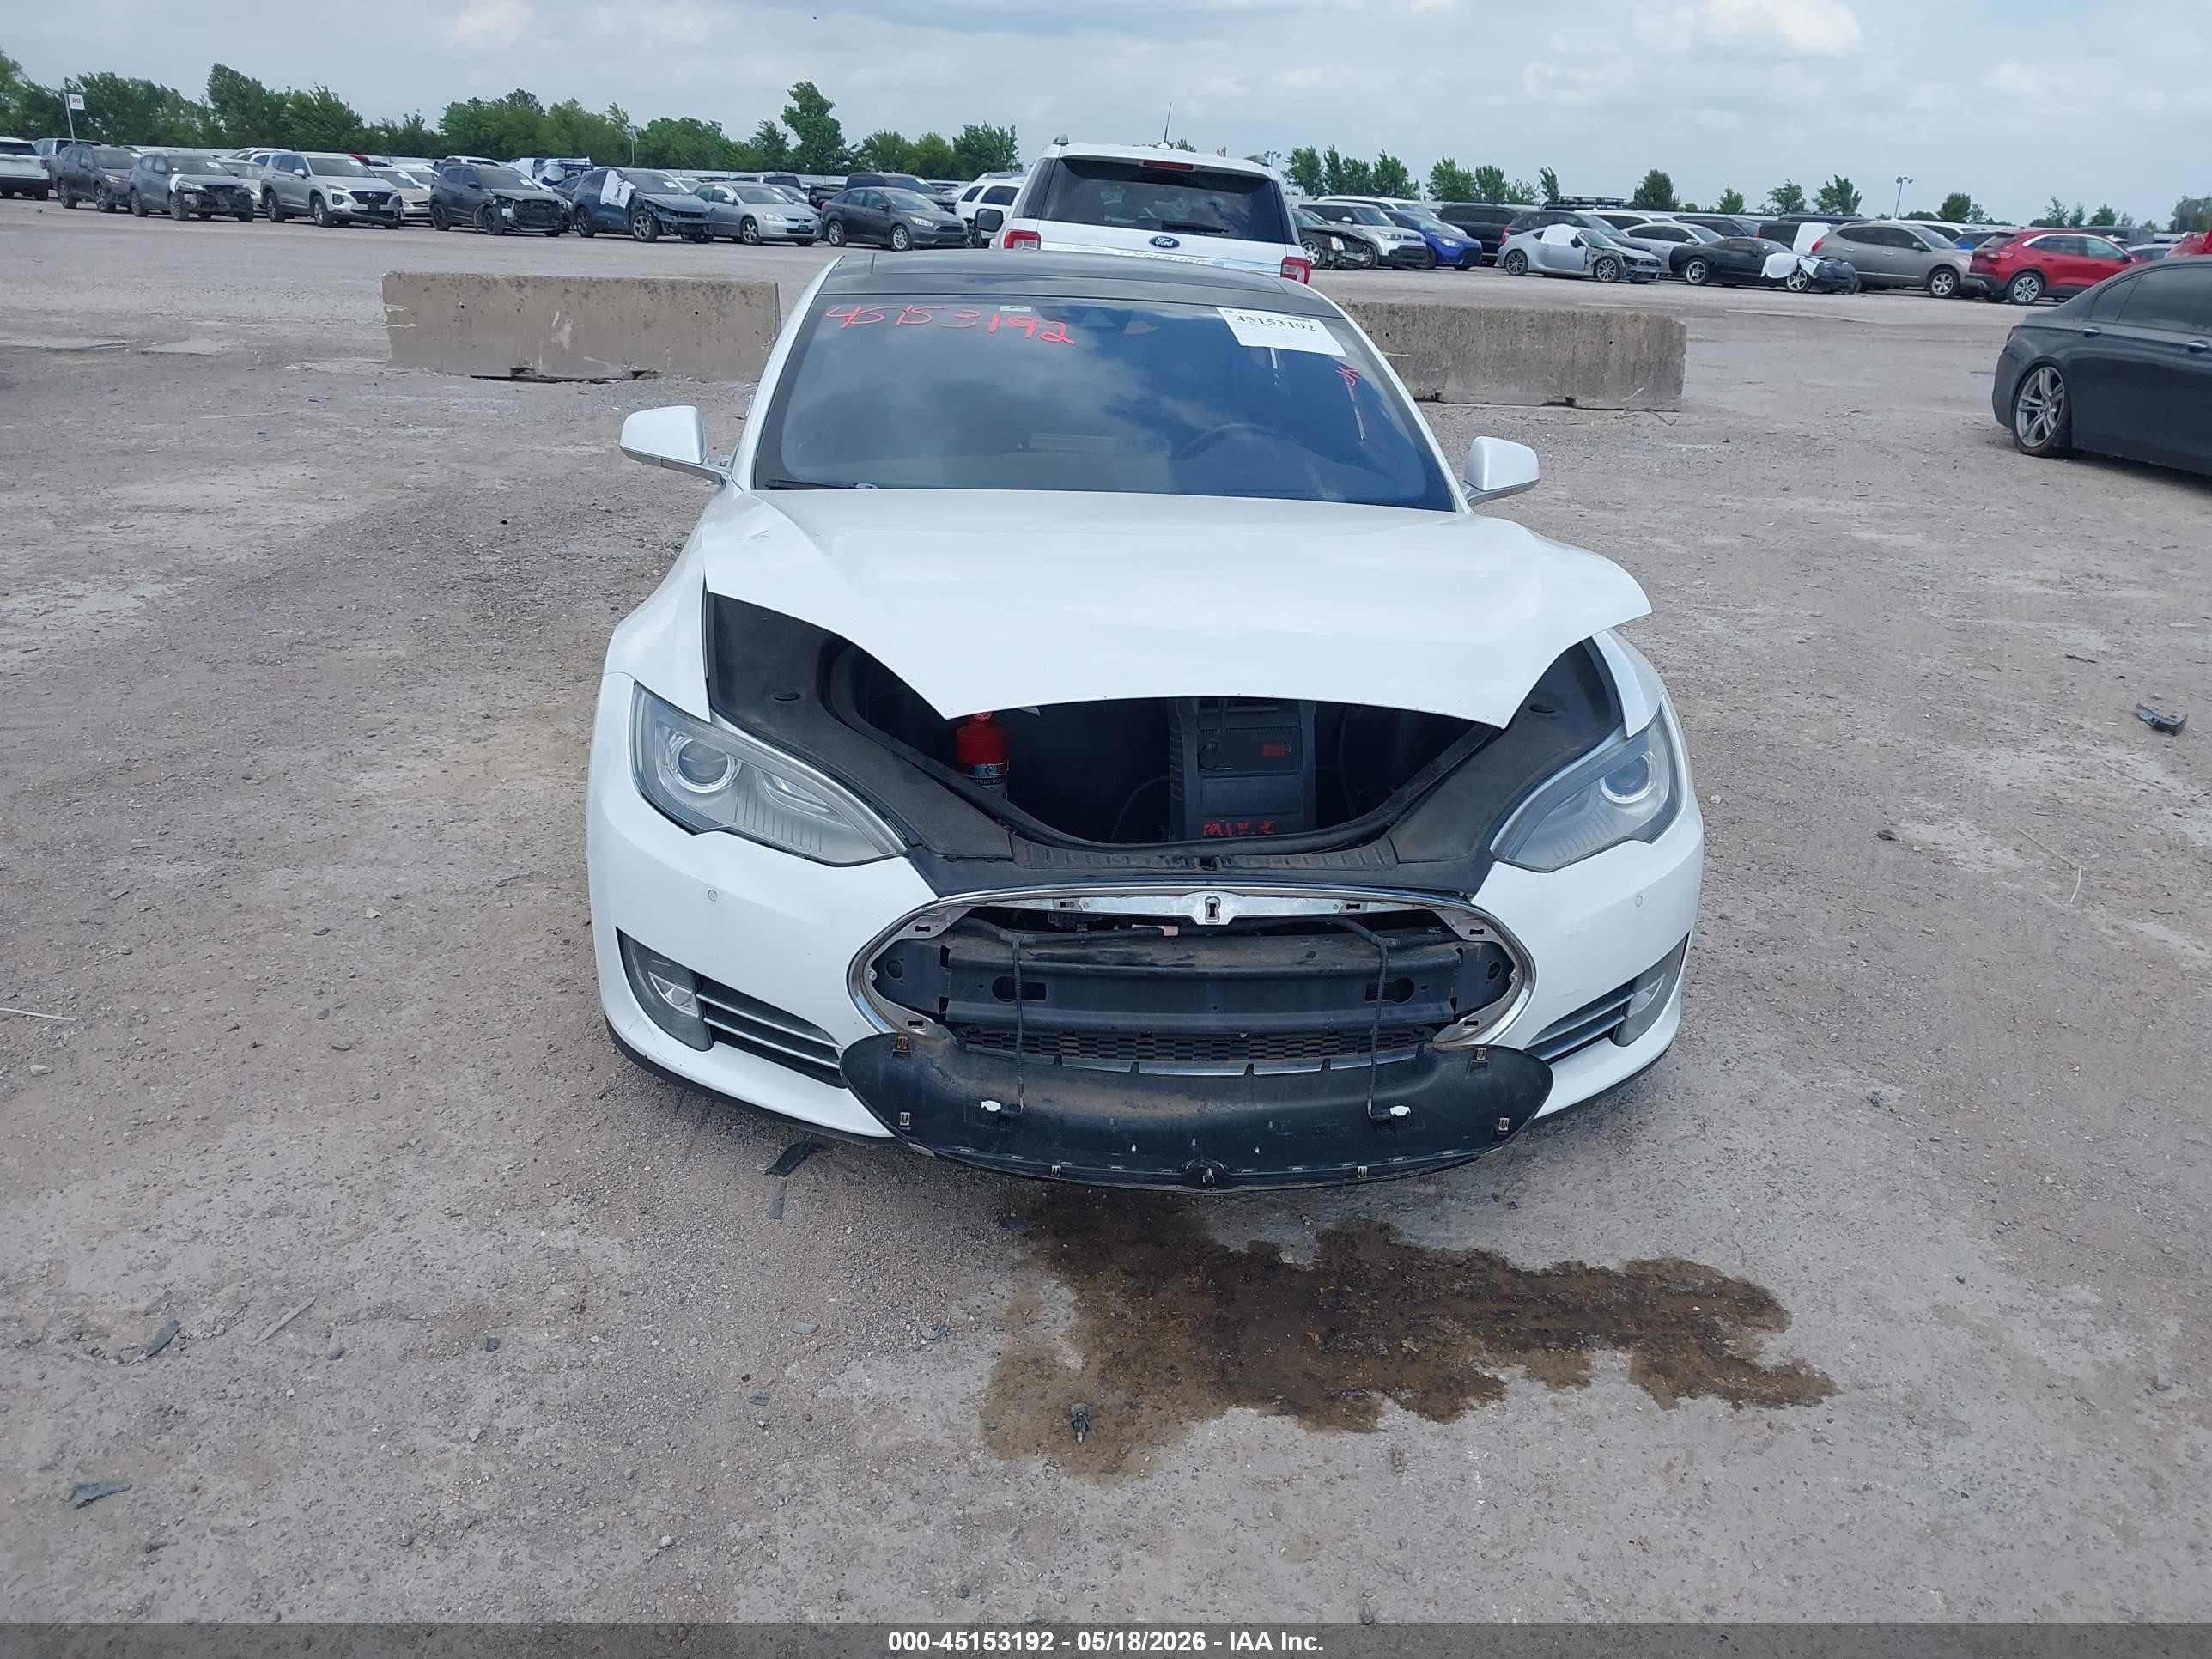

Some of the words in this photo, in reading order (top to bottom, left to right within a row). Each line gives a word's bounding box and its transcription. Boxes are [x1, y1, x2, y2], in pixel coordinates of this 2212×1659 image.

[1155, 236, 1175, 246] Ford
[825, 303, 1076, 345] 45153192
[1237, 315, 1316, 331] 45153192
